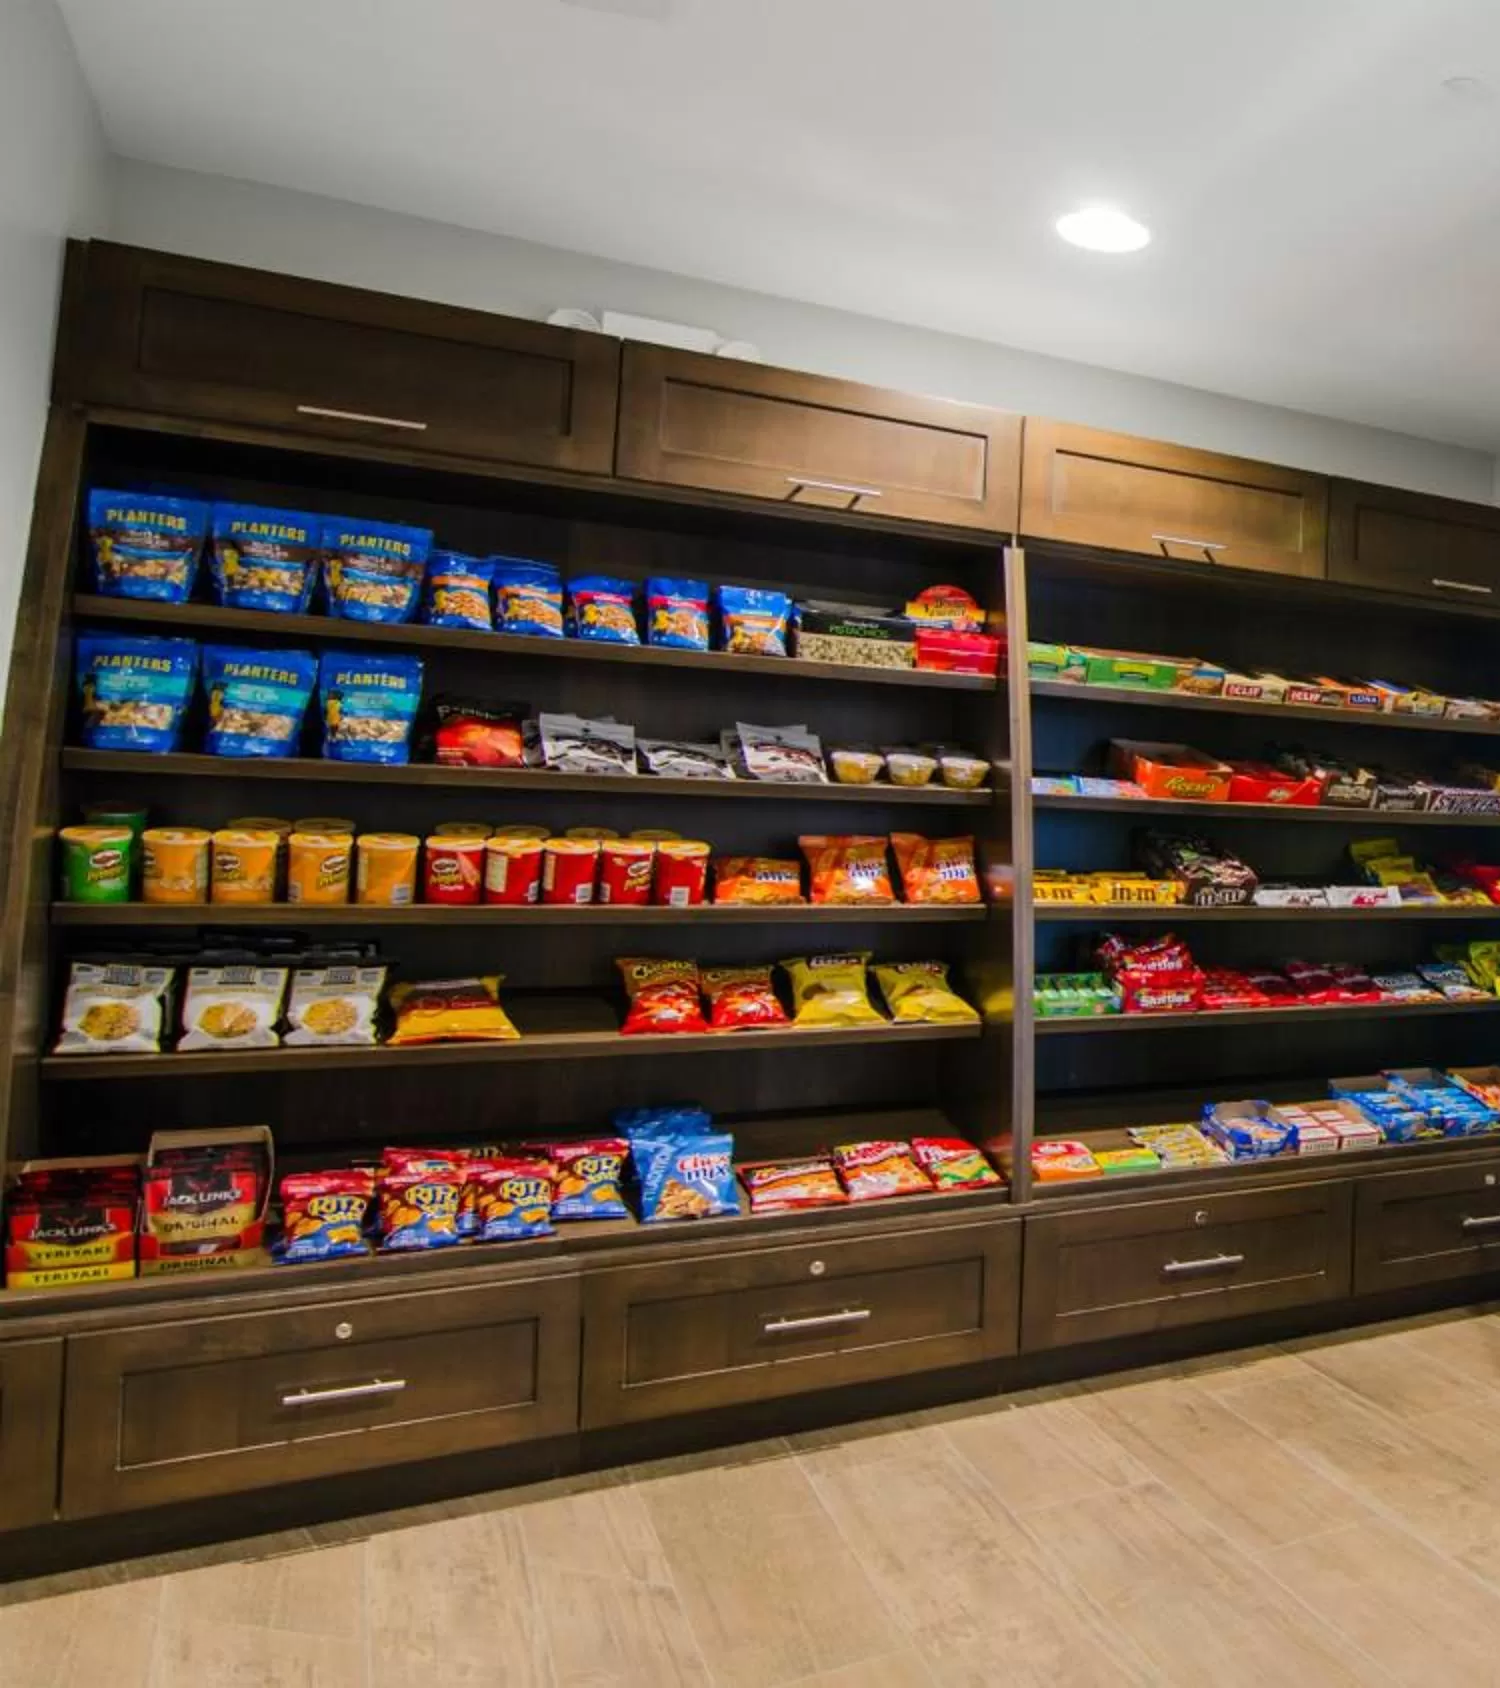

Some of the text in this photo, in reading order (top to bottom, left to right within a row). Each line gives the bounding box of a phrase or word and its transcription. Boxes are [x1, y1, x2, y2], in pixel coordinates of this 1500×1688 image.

[106, 507, 187, 531] PLANTERS
[231, 520, 306, 543] PLANTERS
[339, 533, 411, 557] PLANTERS
[93, 655, 173, 673] PLANTERS
[223, 663, 298, 685] PLANTERS
[336, 671, 407, 690] PLANTERS
[576, 1157, 622, 1177] RITZ
[504, 1180, 551, 1200] RITZ
[163, 1193, 199, 1207] JACK
[312, 1197, 365, 1217] RITZ
[31, 1226, 67, 1240] JACK
[35, 1246, 111, 1261] TERIYAKI
[160, 1255, 236, 1271] ORIGINAL
[32, 1267, 109, 1283] TERIYAKI
